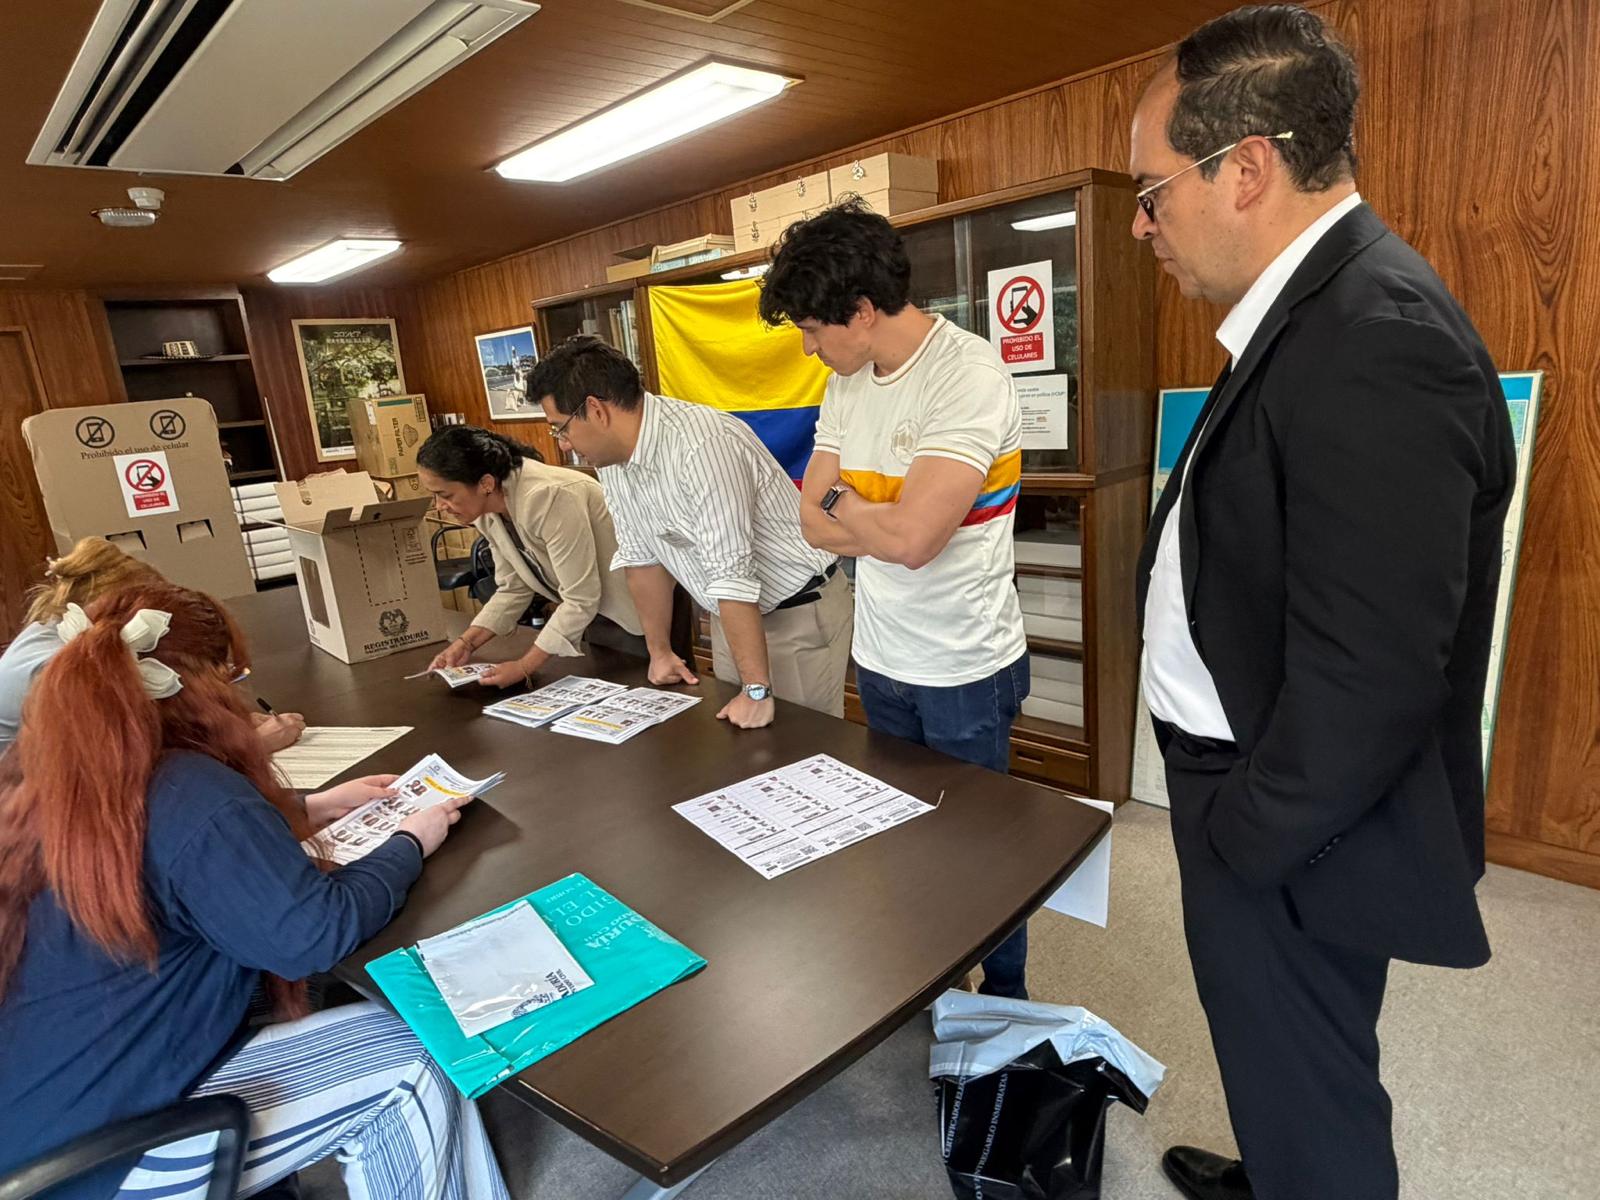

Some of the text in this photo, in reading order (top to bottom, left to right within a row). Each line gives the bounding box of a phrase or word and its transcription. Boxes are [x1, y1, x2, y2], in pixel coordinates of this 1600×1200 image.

[1002, 335, 1034, 345] PROHIBIDO
[1011, 344, 1024, 352] USO
[1007, 351, 1038, 361] CELULARES
[80, 449, 124, 460] Prohibido
[125, 447, 133, 455] el
[150, 443, 161, 451] de
[162, 441, 189, 451] celular
[944, 1100, 962, 1158] CERTIFICADOS
